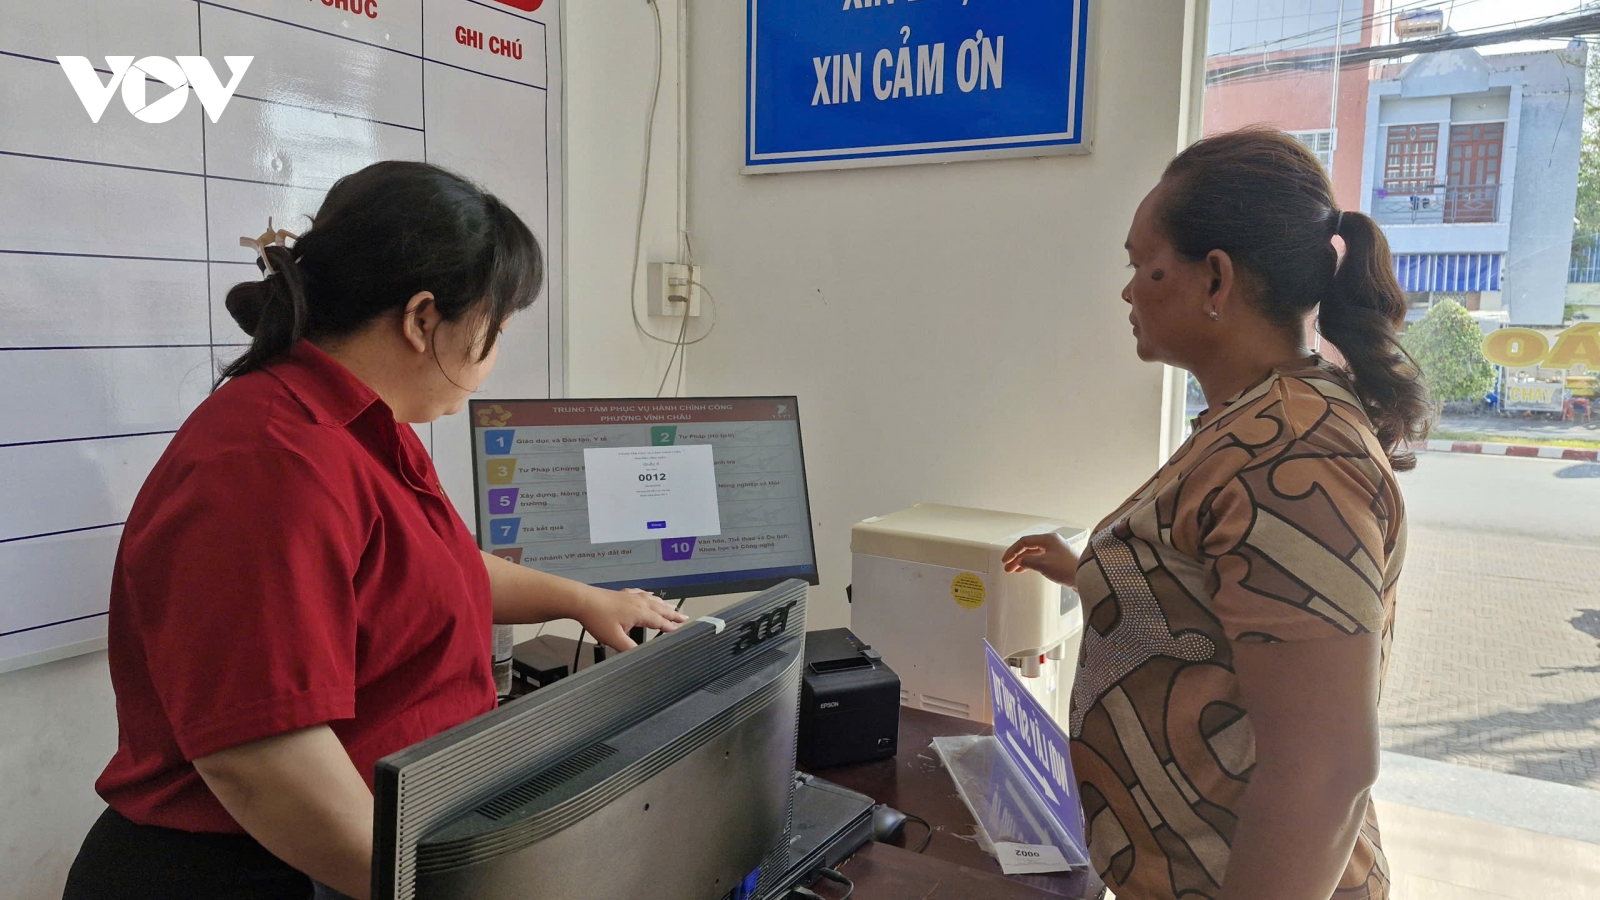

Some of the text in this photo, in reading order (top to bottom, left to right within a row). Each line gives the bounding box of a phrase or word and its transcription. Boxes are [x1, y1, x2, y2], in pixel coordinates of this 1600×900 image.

[455, 25, 522, 60] GHI CHÚ
[811, 26, 1004, 106] XIN CẢM ƠN
[610, 406, 636, 414] PHỤC
[496, 436, 504, 448] 1
[660, 432, 670, 442] 2
[497, 466, 508, 477] 3
[638, 473, 666, 482] 0012
[500, 496, 510, 506] 5
[501, 526, 512, 537] 7
[671, 542, 690, 553] 10
[731, 600, 798, 655] acer
